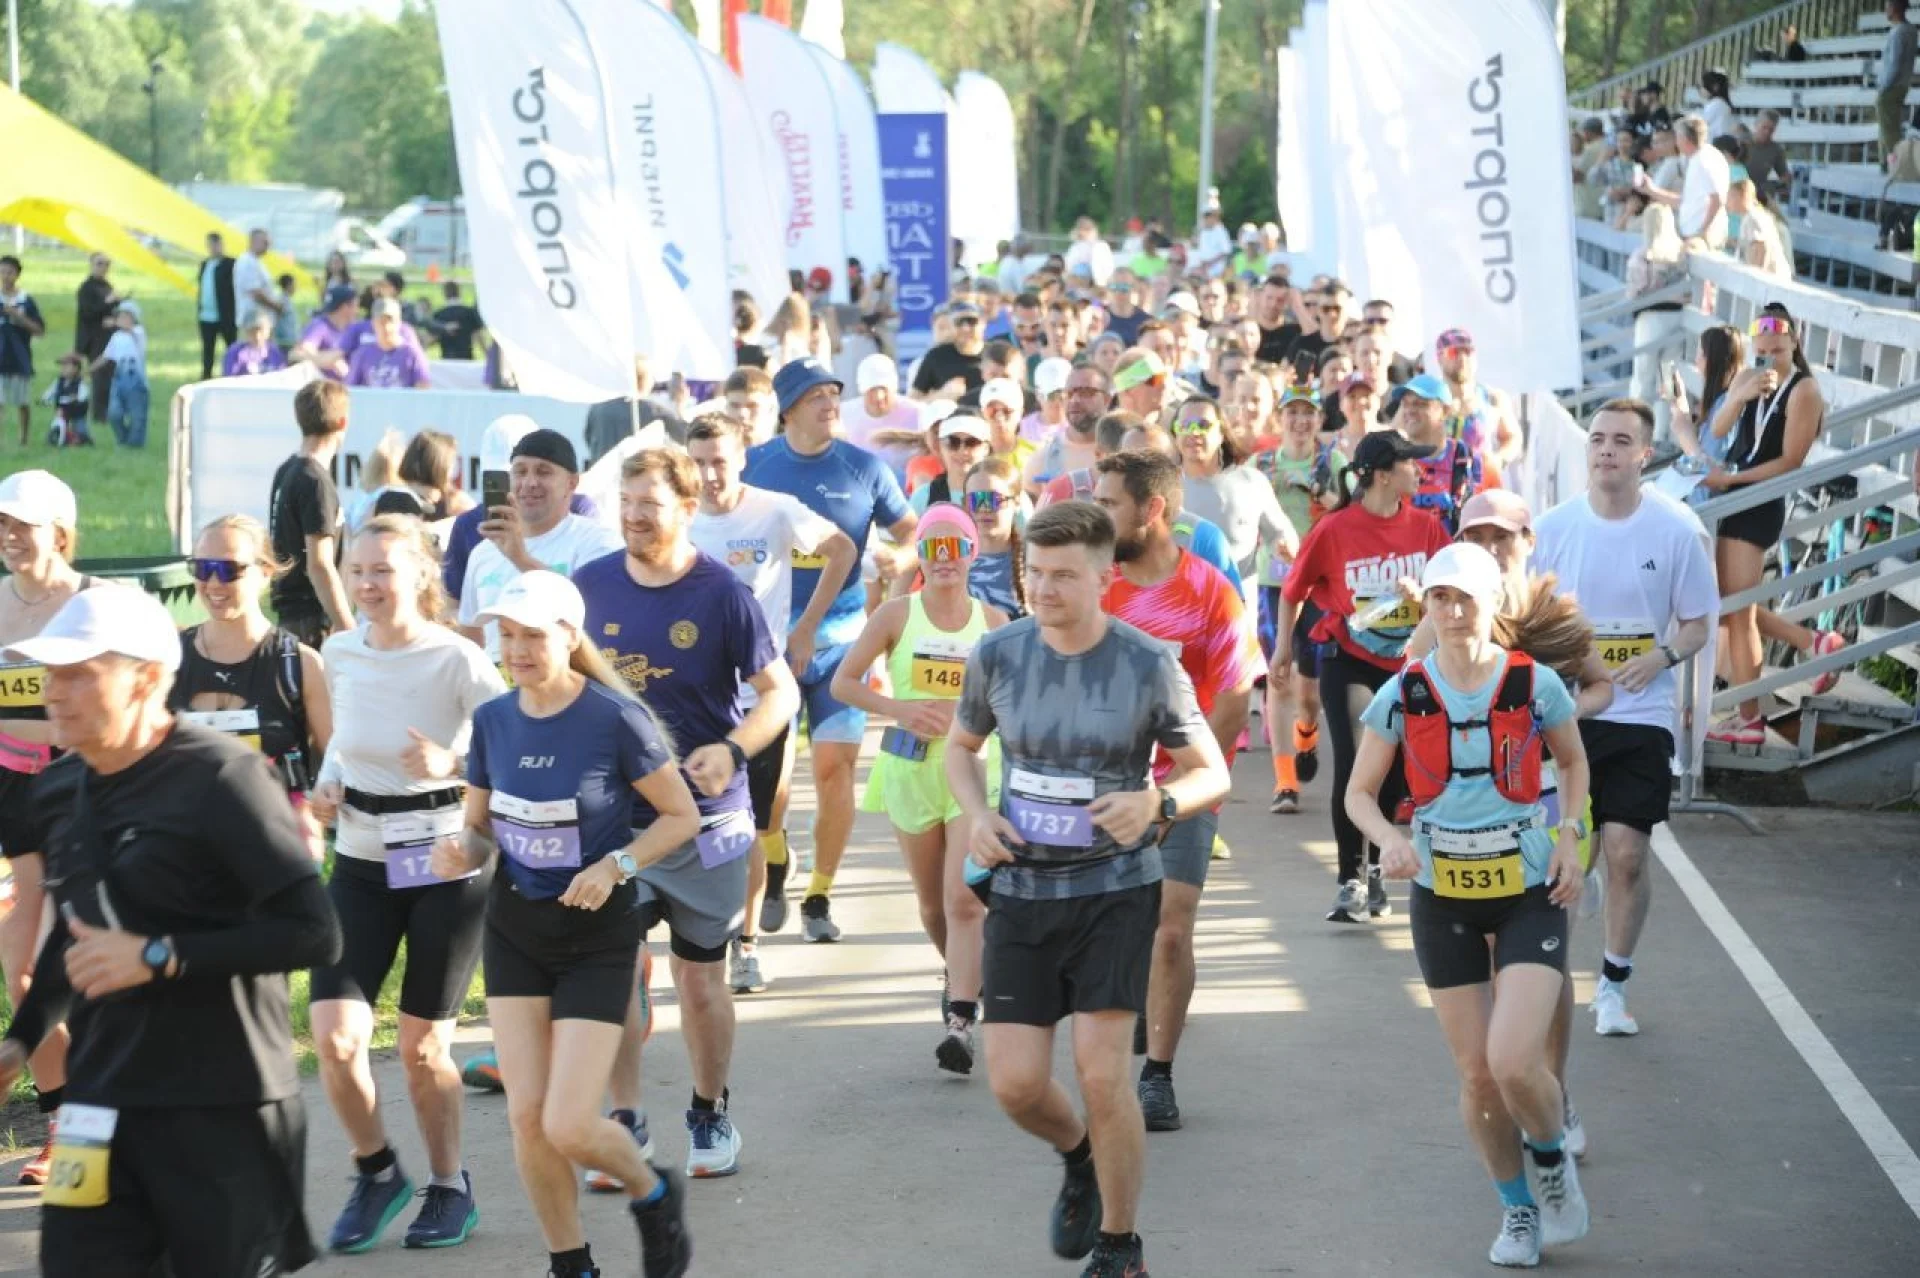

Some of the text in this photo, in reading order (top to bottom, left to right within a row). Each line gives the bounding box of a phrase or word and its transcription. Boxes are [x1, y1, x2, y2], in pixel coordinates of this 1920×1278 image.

[1601, 646, 1642, 662] 485
[0, 677, 41, 698] 145
[924, 668, 962, 688] 148
[518, 755, 556, 769] RUN
[1018, 808, 1077, 836] 1737
[503, 831, 565, 859] 1742
[711, 834, 748, 855] 17
[402, 853, 434, 878] 17
[1445, 866, 1506, 890] 1531
